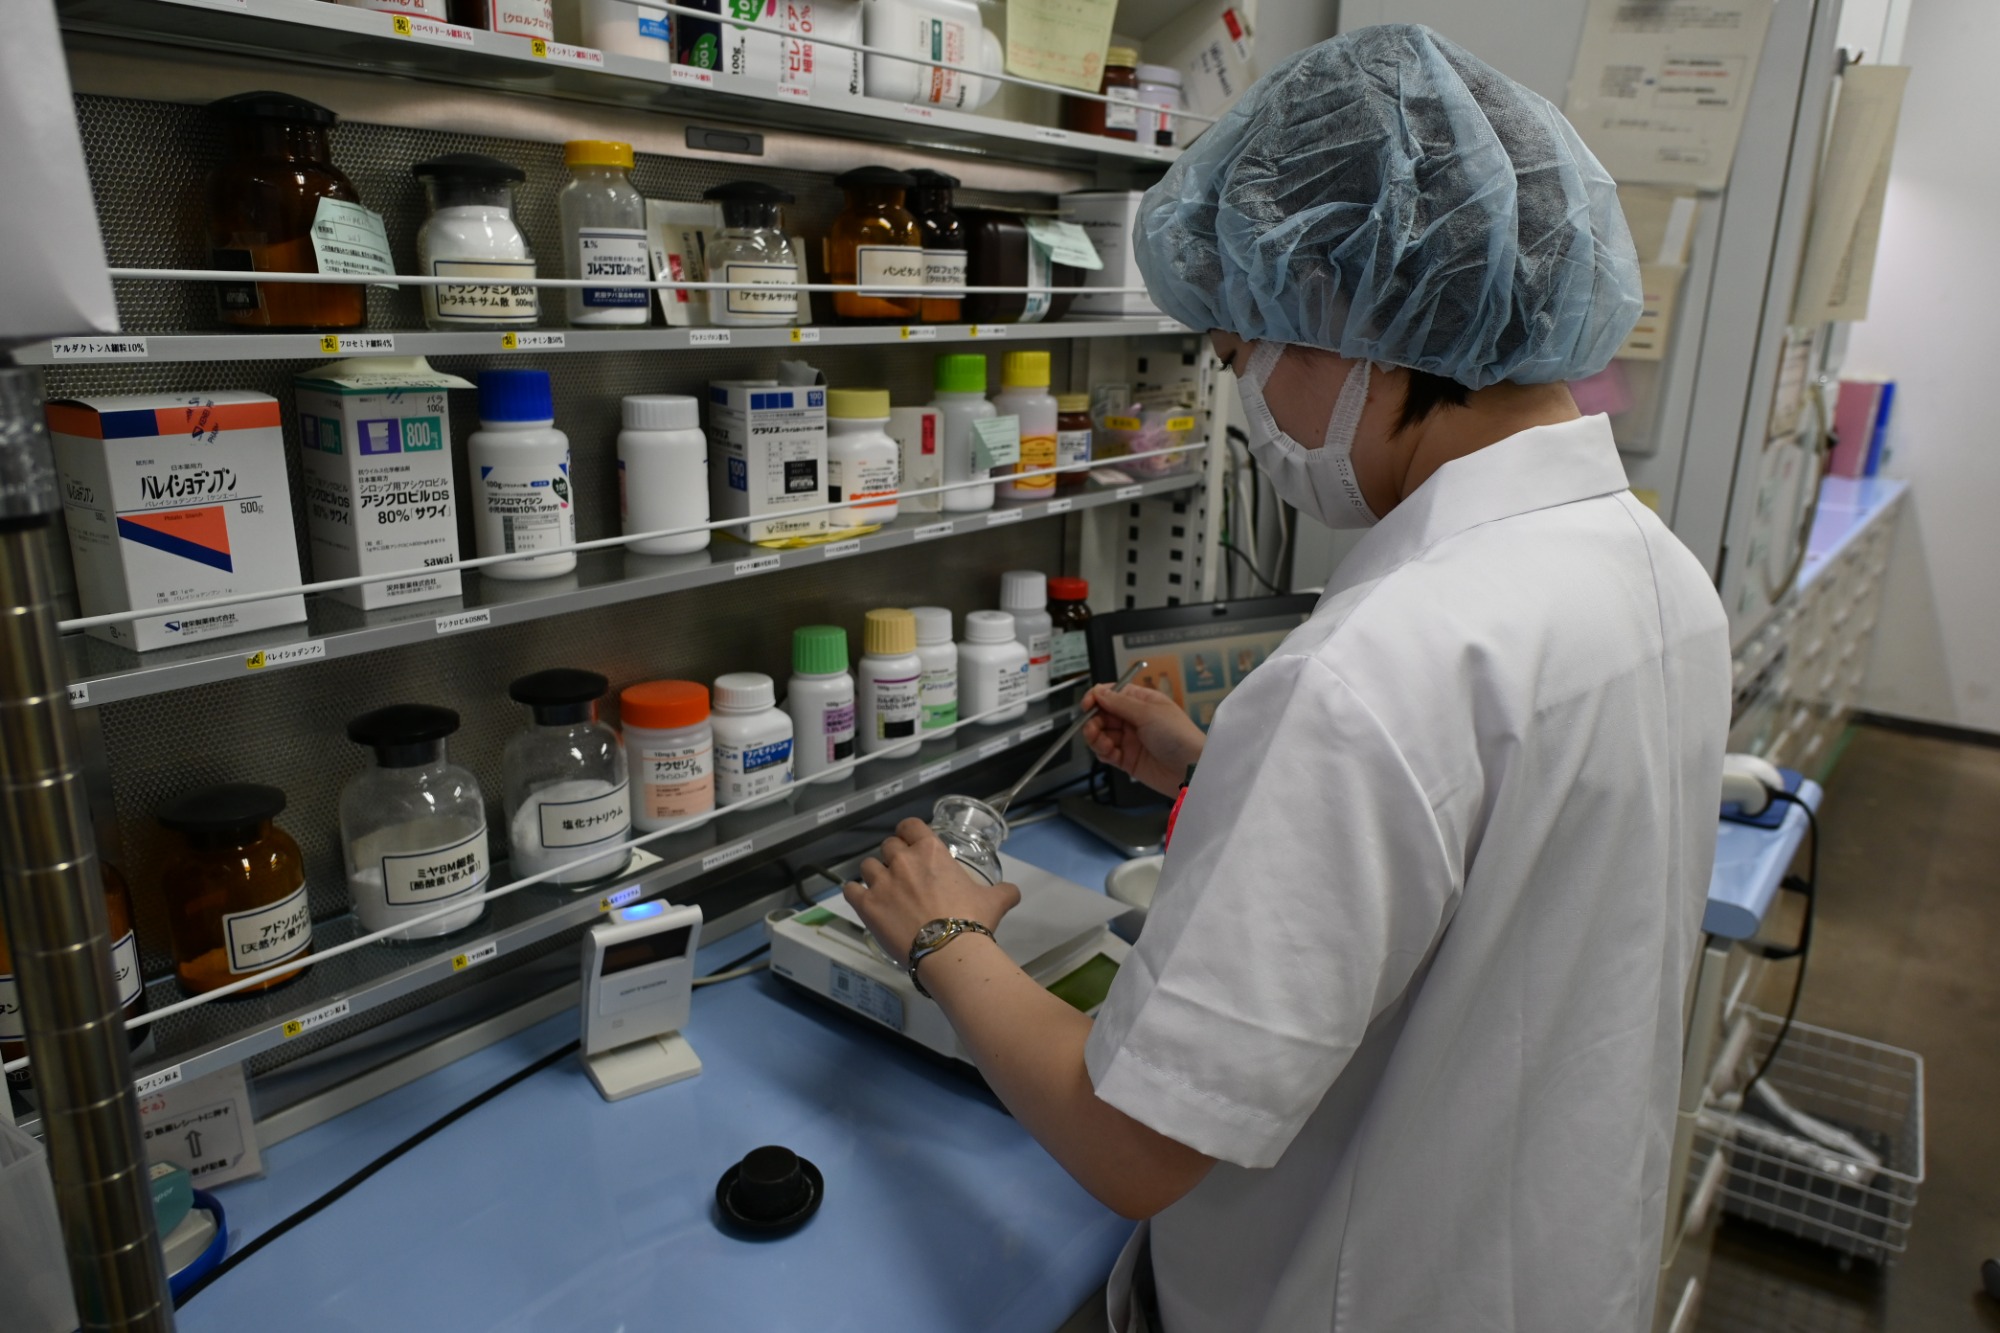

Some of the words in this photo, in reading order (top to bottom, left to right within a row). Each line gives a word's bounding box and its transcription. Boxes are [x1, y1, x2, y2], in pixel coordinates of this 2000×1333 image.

[54, 343, 145, 353] アルダクトンA細粒10%
[340, 338, 392, 348] フロセミド細粒4%
[518, 336, 564, 345] トランサミン散50%
[427, 404, 445, 413] 100g
[406, 422, 431, 447] 800
[140, 467, 237, 500] バレイショデンプン
[360, 478, 448, 494] シロップ用アシクロビル
[361, 490, 450, 508] アシクロビルDS
[240, 501, 264, 514] 500g
[424, 553, 454, 567] sawai
[265, 645, 322, 661] バレイショデンプン
[654, 757, 696, 771] ナウゼリン
[562, 806, 623, 830] 塩化ナトリウム
[417, 852, 475, 878] ミヤBM細粒
